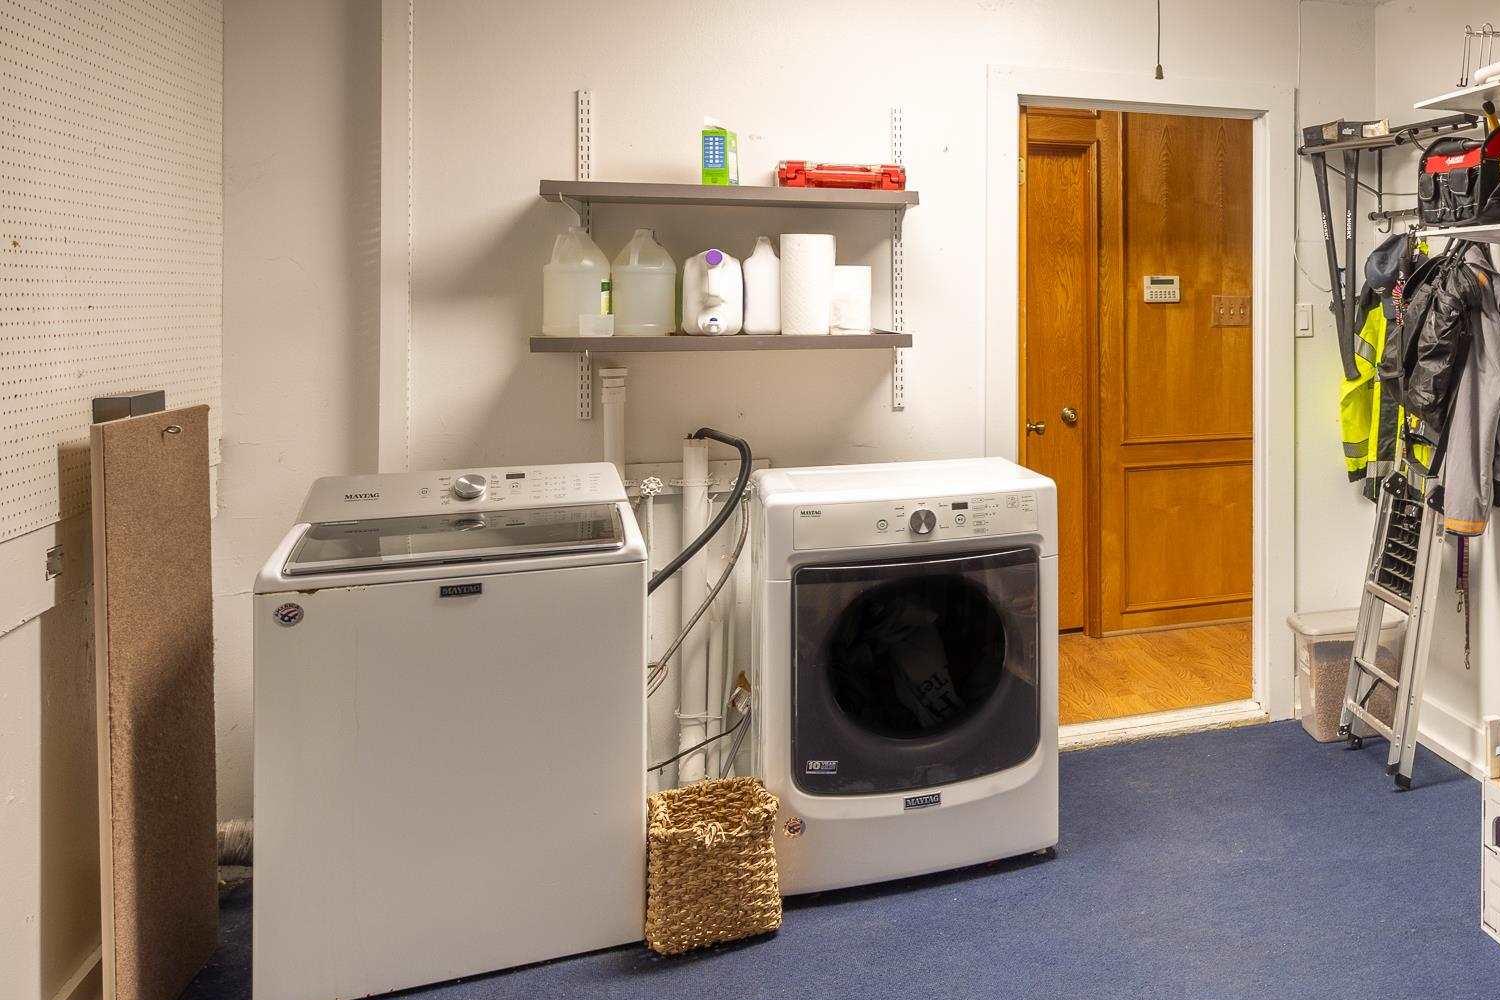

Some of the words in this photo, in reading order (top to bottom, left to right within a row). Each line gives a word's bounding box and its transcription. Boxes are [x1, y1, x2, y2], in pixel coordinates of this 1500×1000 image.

[344, 492, 380, 500] MAYTAG
[441, 584, 481, 596] MAYTAG
[906, 794, 940, 807] MAYTAG
